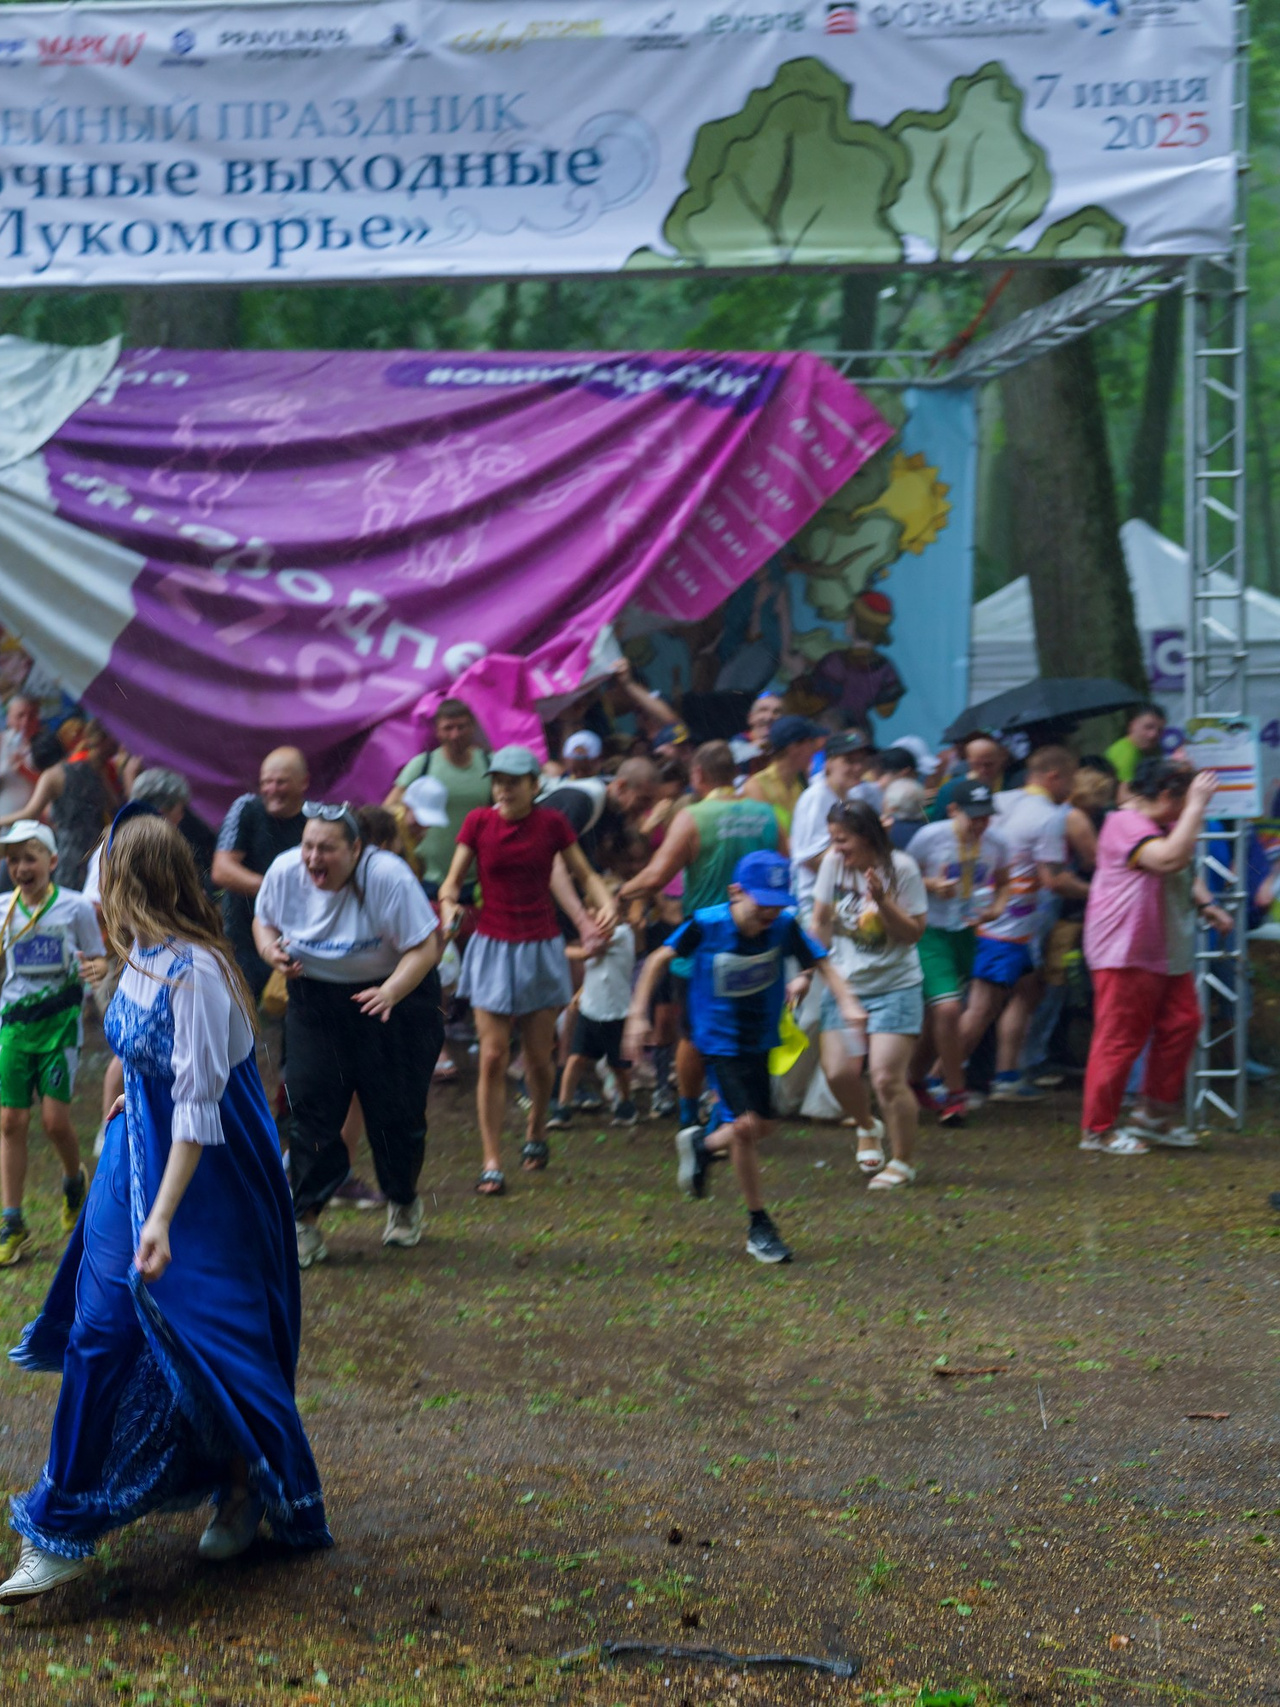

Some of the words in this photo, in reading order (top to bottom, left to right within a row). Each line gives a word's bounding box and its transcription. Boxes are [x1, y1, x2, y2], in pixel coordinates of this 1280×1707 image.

[1033, 75, 1059, 109] 7
[1073, 75, 1208, 110] июня
[217, 91, 528, 143] ПРАЗДНИК
[1104, 113, 1209, 151] 2025
[223, 146, 603, 202] выходные
